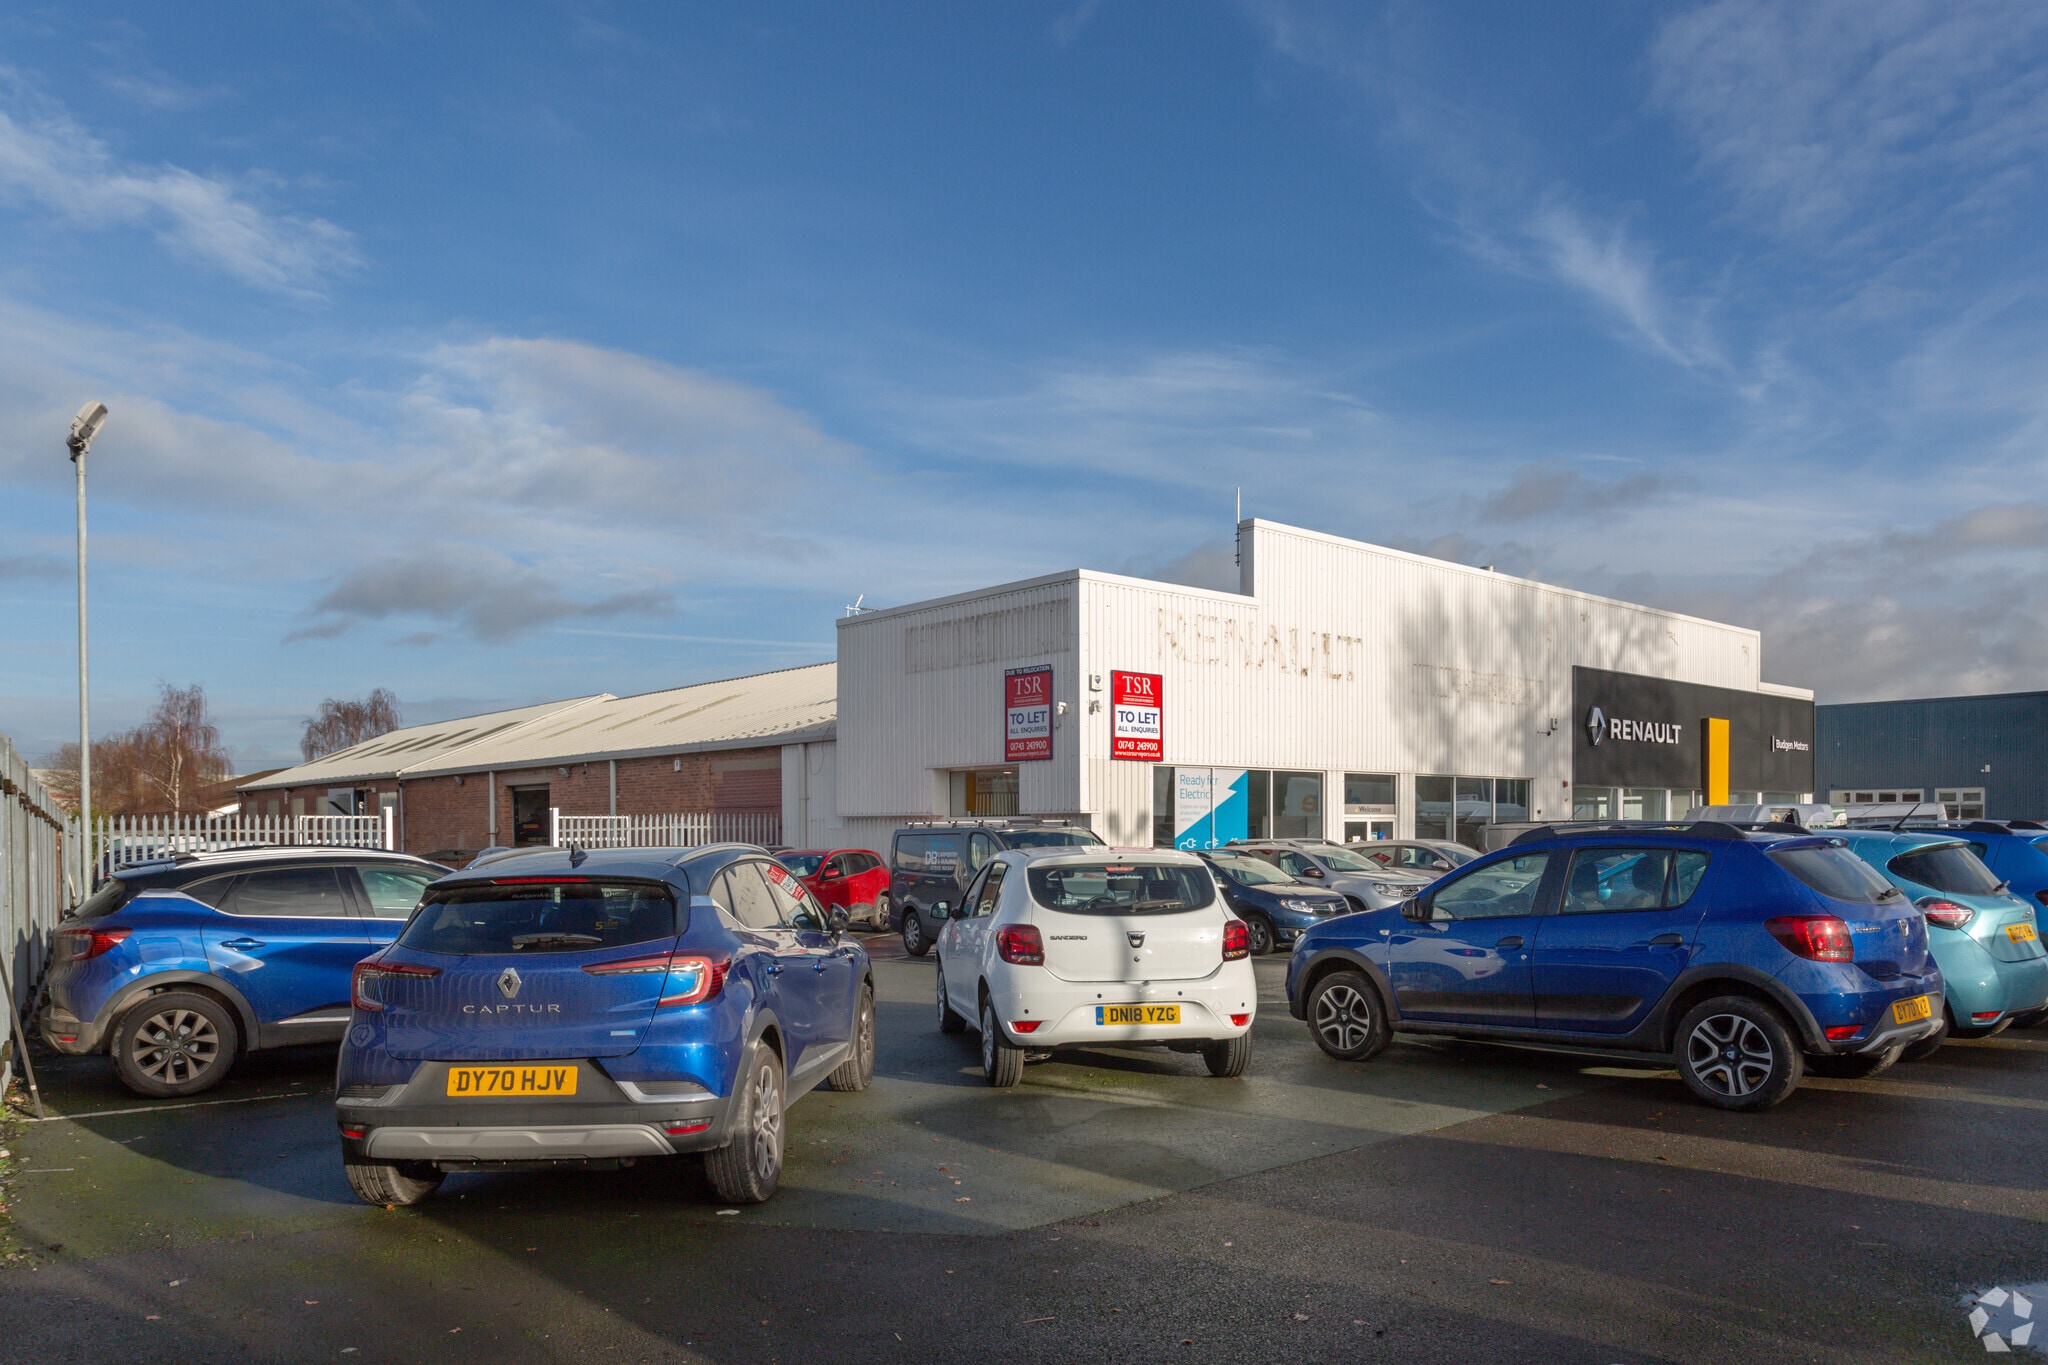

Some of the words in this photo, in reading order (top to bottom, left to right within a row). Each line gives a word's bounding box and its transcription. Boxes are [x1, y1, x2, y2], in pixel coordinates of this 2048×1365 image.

[1023, 664, 1050, 674] RELOCATION
[1014, 676, 1043, 695] TSR
[1122, 675, 1154, 696] TSR
[1010, 712, 1024, 725] TO
[1027, 710, 1048, 724] LET
[1117, 710, 1135, 723] TO
[1138, 711, 1158, 725] LET
[1020, 725, 1048, 734] ENQUIRIES
[1117, 725, 1128, 733] ALL
[1130, 725, 1159, 734] ENQUIRIES
[1610, 718, 1682, 745] RENAULT
[1010, 742, 1024, 751] 01743
[1026, 740, 1047, 750] 243900
[1117, 740, 1135, 750] 01743
[1136, 741, 1158, 751] 243900
[1775, 738, 1793, 752] Budgen
[1793, 740, 1809, 751] Motors
[1179, 774, 1206, 789] Ready
[1179, 788, 1214, 800] Electric
[1359, 805, 1382, 813] Welcome
[925, 850, 938, 865] DB
[462, 1003, 561, 1015] CAPTUR
[1109, 1007, 1143, 1023] DN18
[1146, 1006, 1176, 1022] YZG
[456, 1070, 516, 1092] DY70
[520, 1069, 567, 1091] HJV
